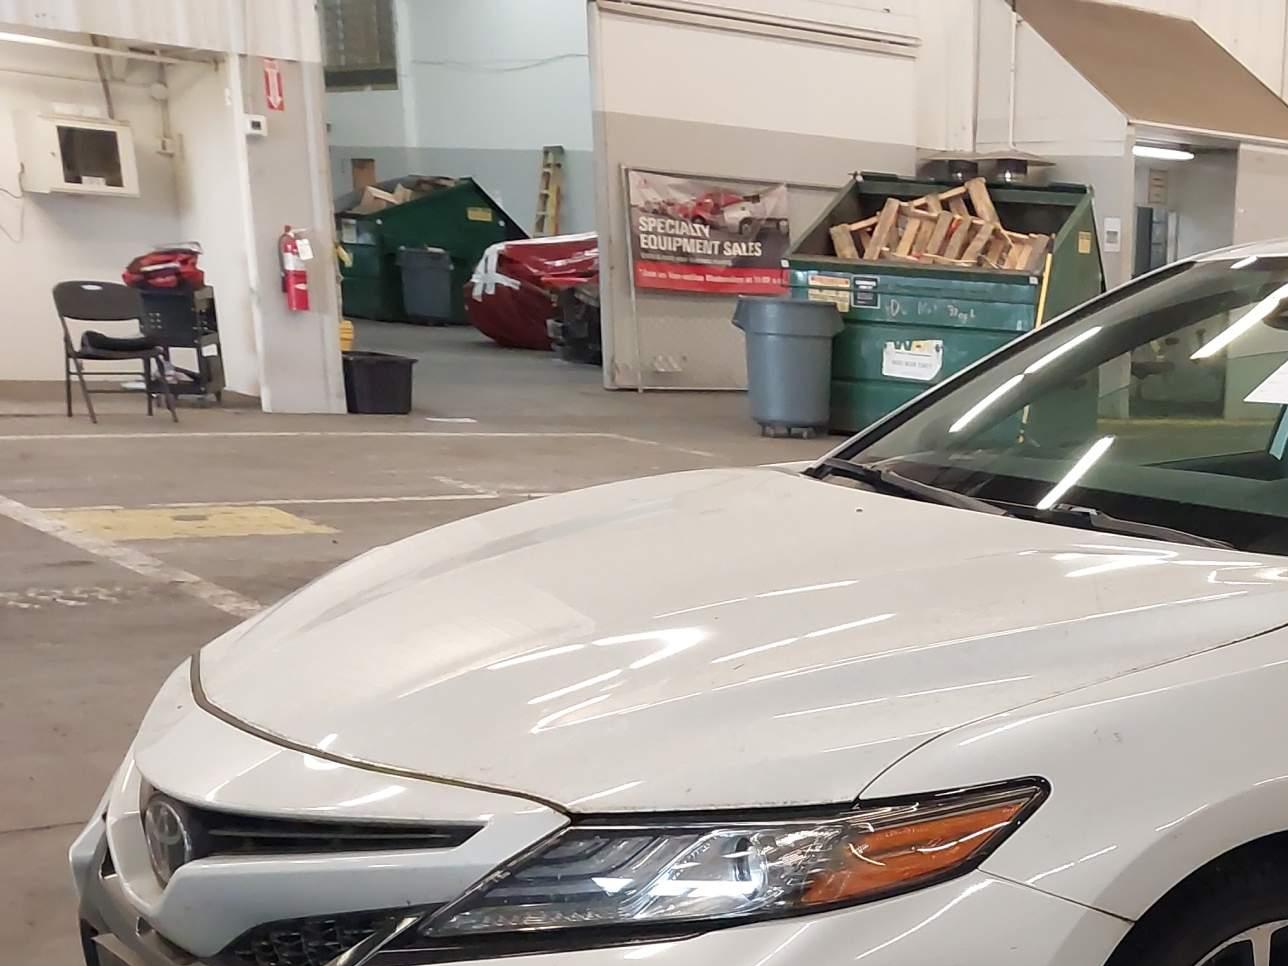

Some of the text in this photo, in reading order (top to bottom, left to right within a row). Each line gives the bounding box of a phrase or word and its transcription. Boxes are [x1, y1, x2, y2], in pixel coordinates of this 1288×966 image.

[638, 216, 711, 239] SPECIALTY
[639, 233, 762, 257] EQUIPMENT SALES
